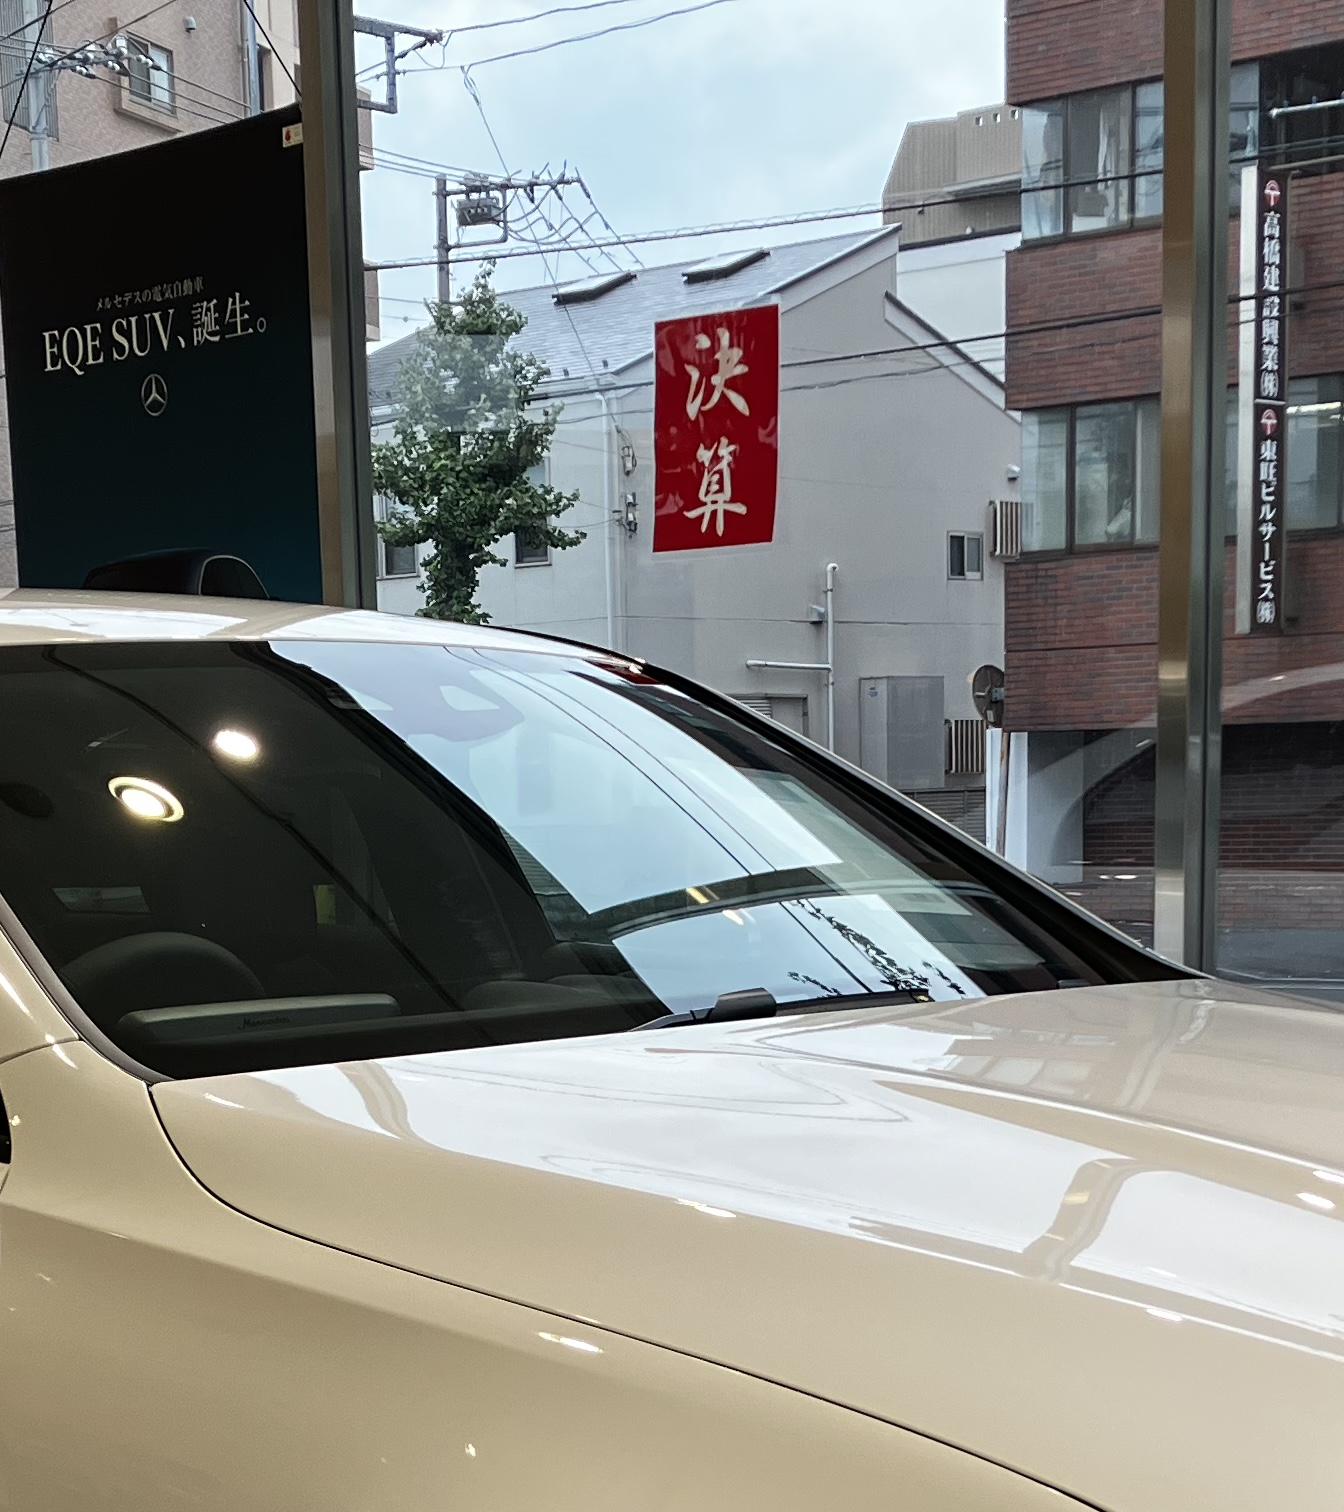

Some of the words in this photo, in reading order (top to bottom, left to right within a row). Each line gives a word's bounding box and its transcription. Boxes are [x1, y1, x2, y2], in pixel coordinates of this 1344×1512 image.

[96, 276, 205, 312] メルセデスの電気自動車
[42, 322, 105, 376] EQE
[683, 327, 750, 537] 決算
